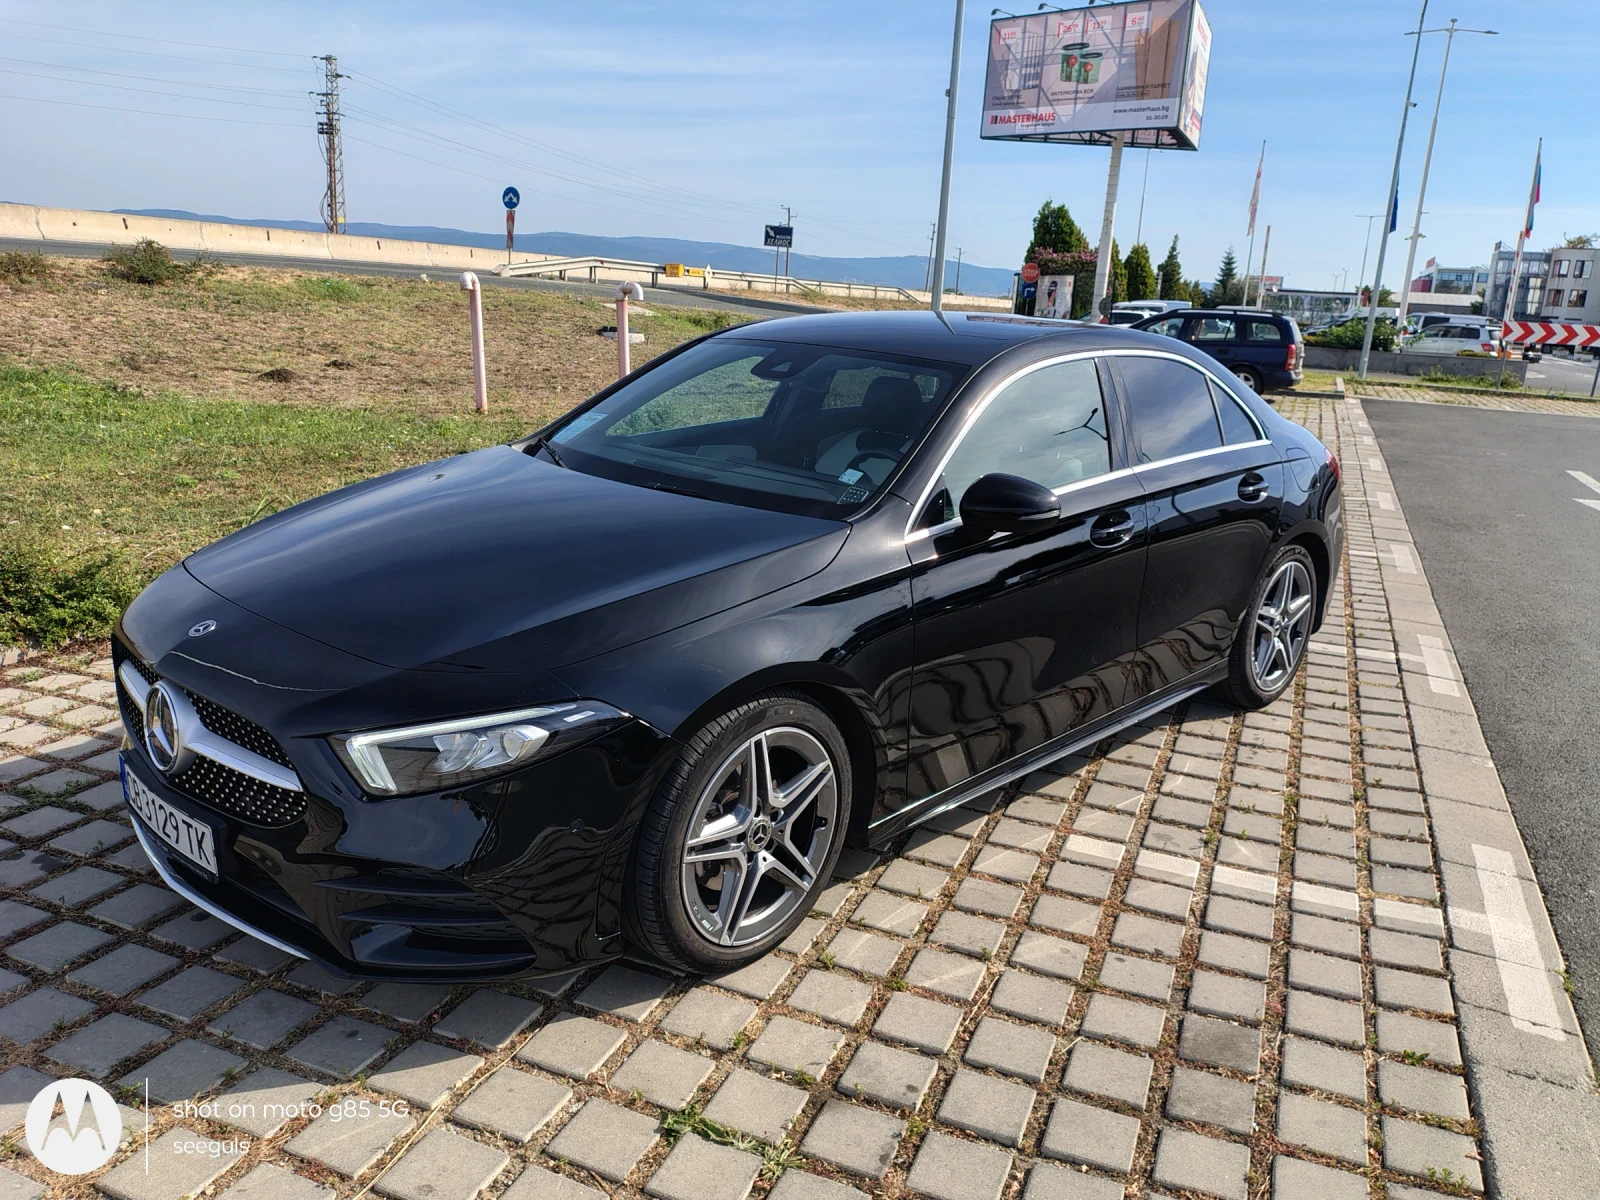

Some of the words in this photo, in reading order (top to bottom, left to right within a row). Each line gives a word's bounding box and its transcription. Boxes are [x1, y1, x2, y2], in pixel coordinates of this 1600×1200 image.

[1113, 104, 1170, 114] www.masterhaus.bg
[998, 112, 1056, 125] MASTERHAUS
[1023, 269, 1039, 277] STOP
